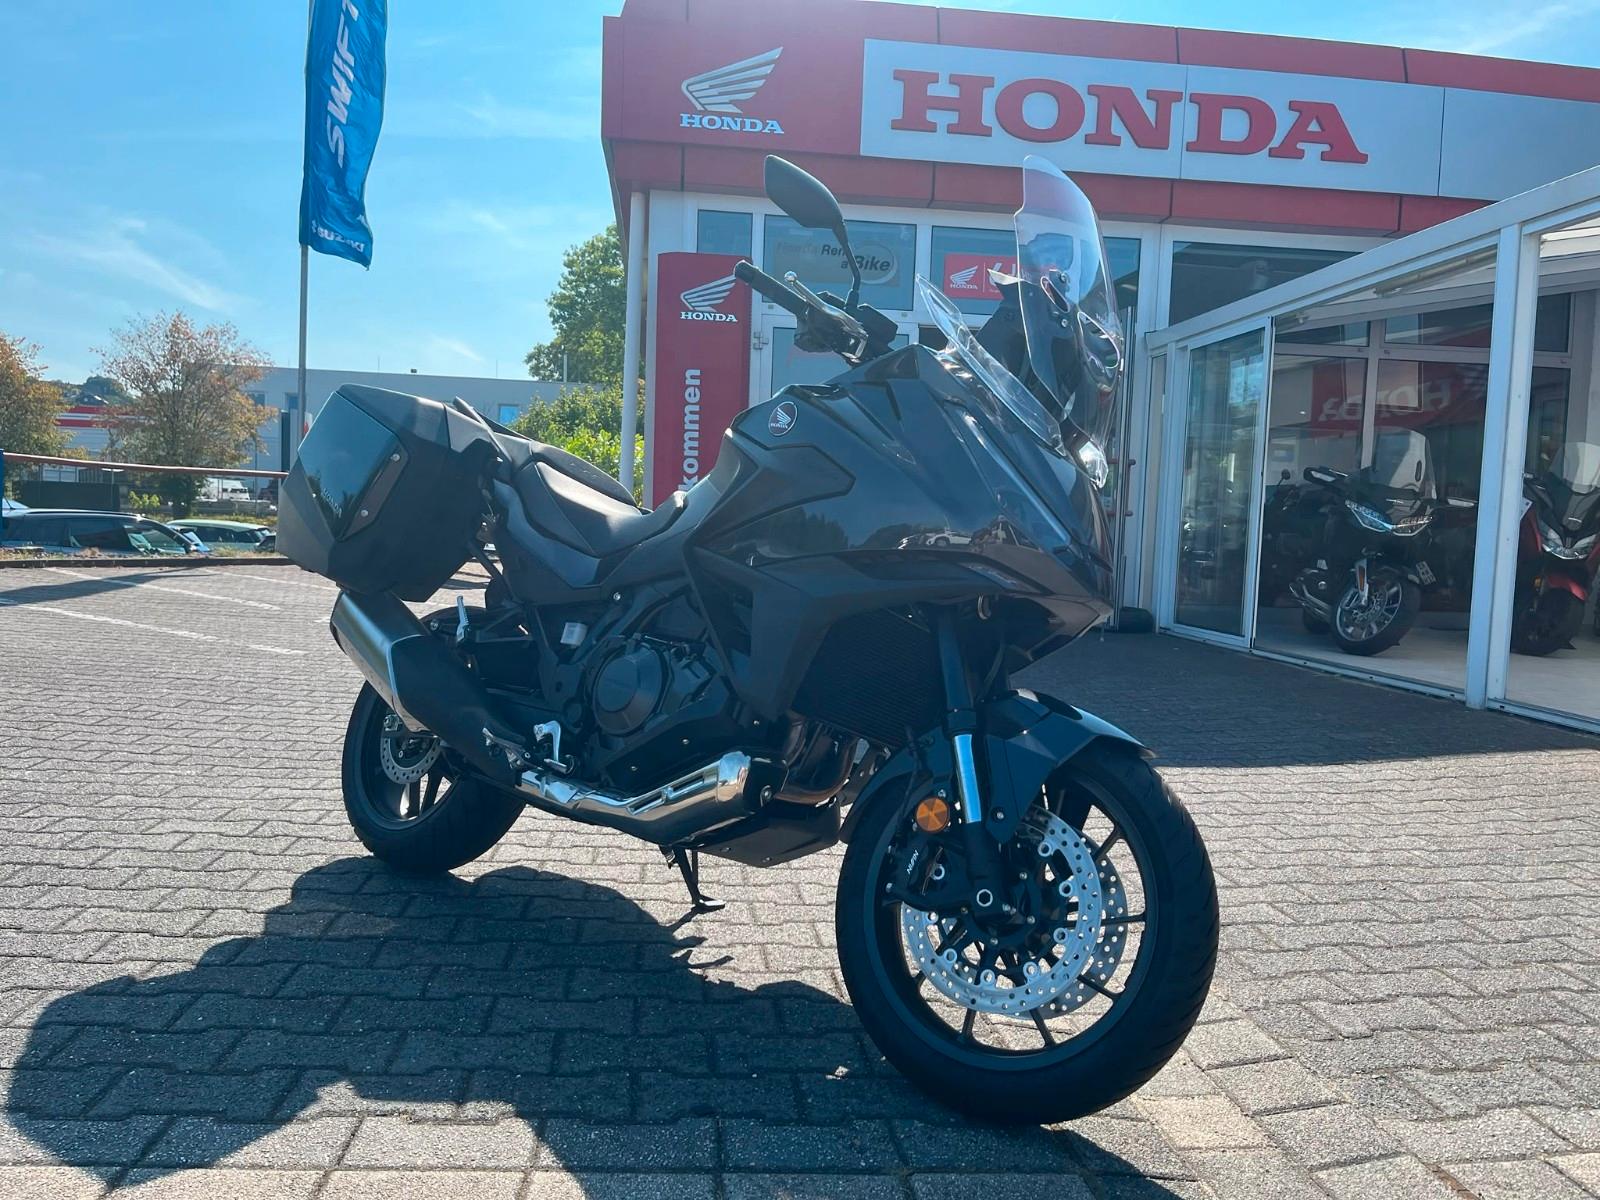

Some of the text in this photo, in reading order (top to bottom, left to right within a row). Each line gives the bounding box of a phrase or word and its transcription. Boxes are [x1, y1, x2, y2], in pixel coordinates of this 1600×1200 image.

[680, 113, 784, 134] HONDA
[890, 69, 1369, 164] HONDA
[821, 243, 847, 256] Ren
[853, 255, 891, 272] Bike
[680, 311, 738, 322] HONDA
